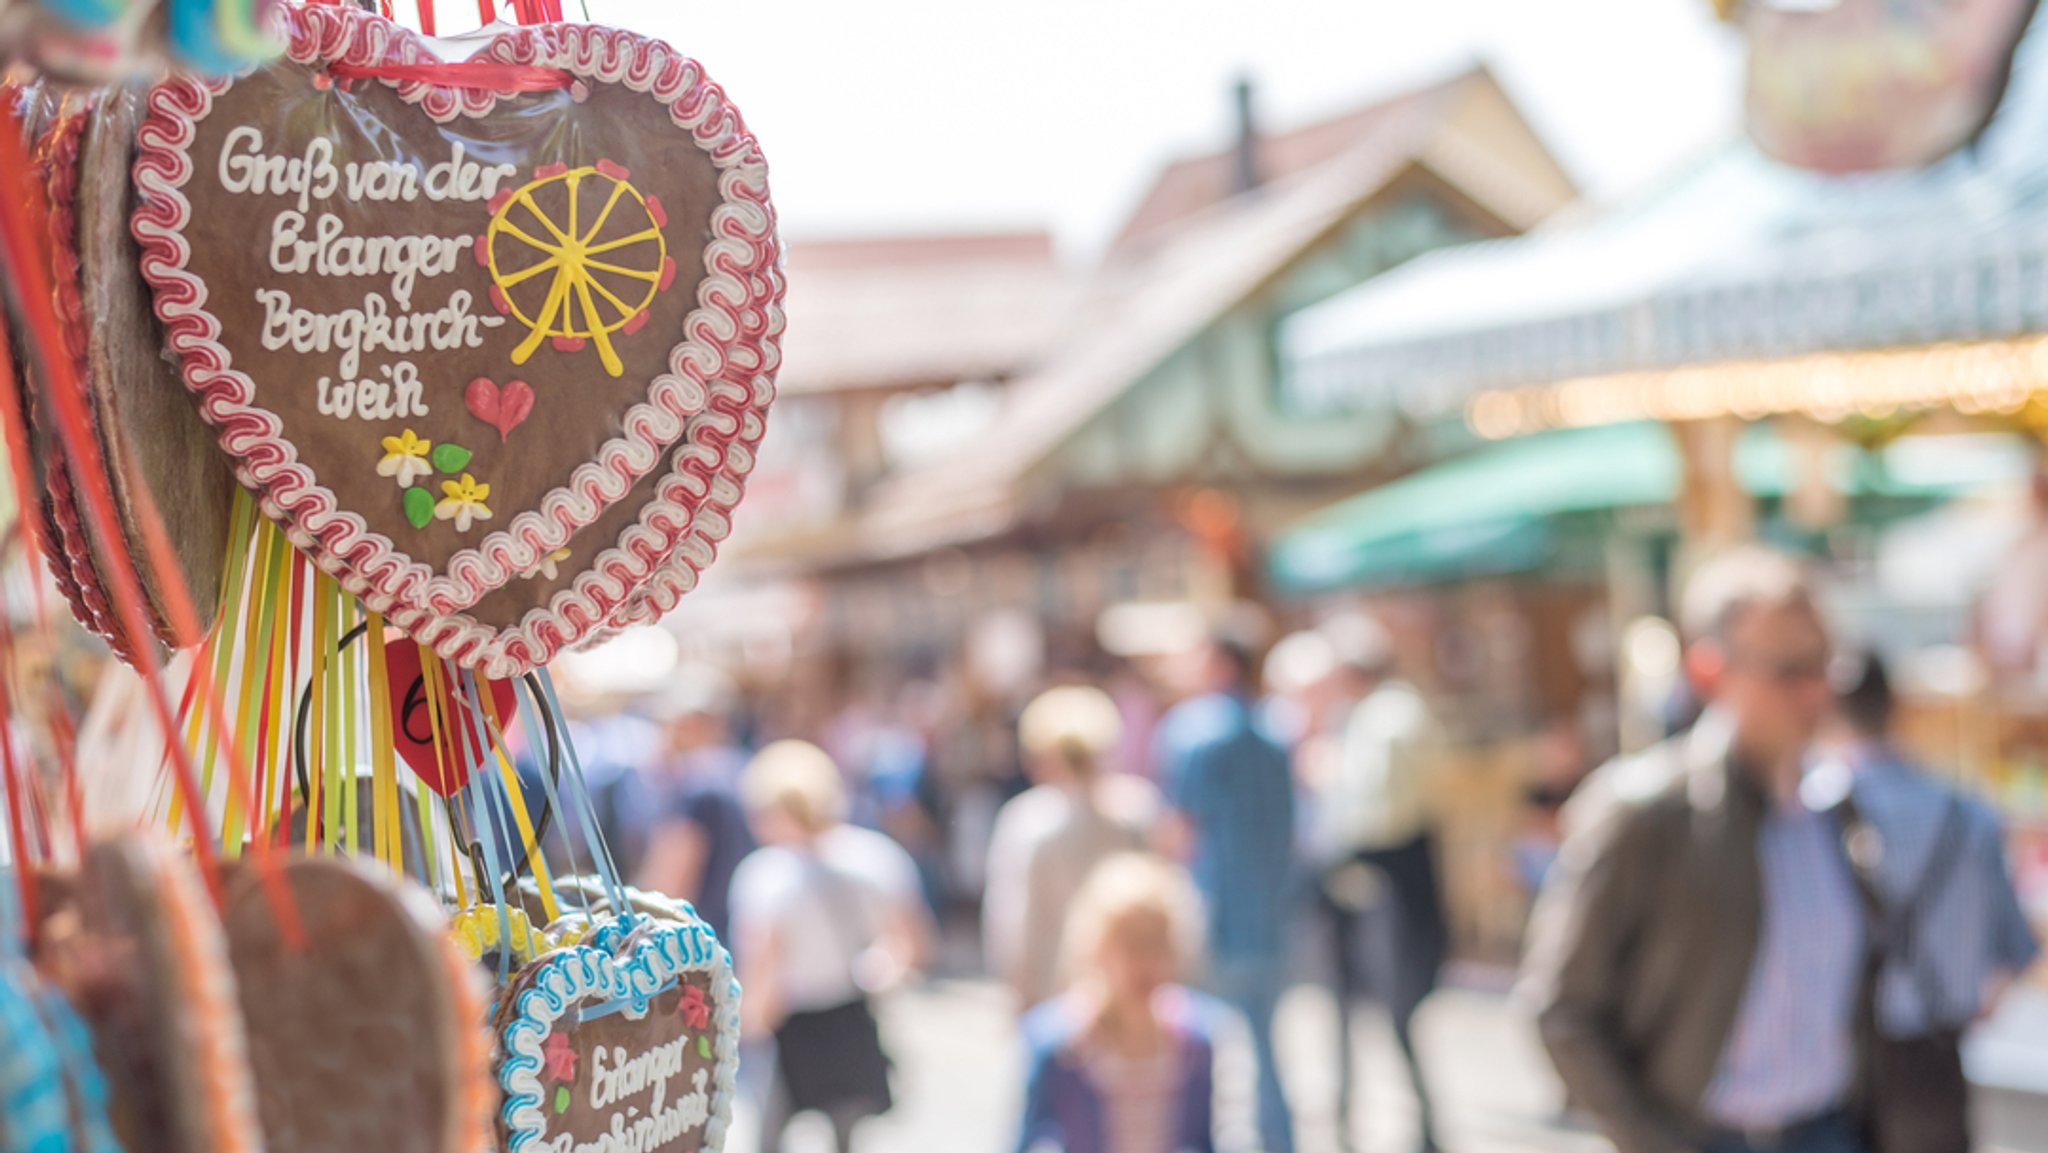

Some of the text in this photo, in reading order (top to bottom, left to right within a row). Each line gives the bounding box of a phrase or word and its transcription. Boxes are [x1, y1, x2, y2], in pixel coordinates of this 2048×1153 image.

[218, 126, 517, 212] Gruß von der
[268, 210, 474, 309] Erlanger
[255, 288, 506, 378] Bergkirch-
[317, 361, 430, 419] weih
